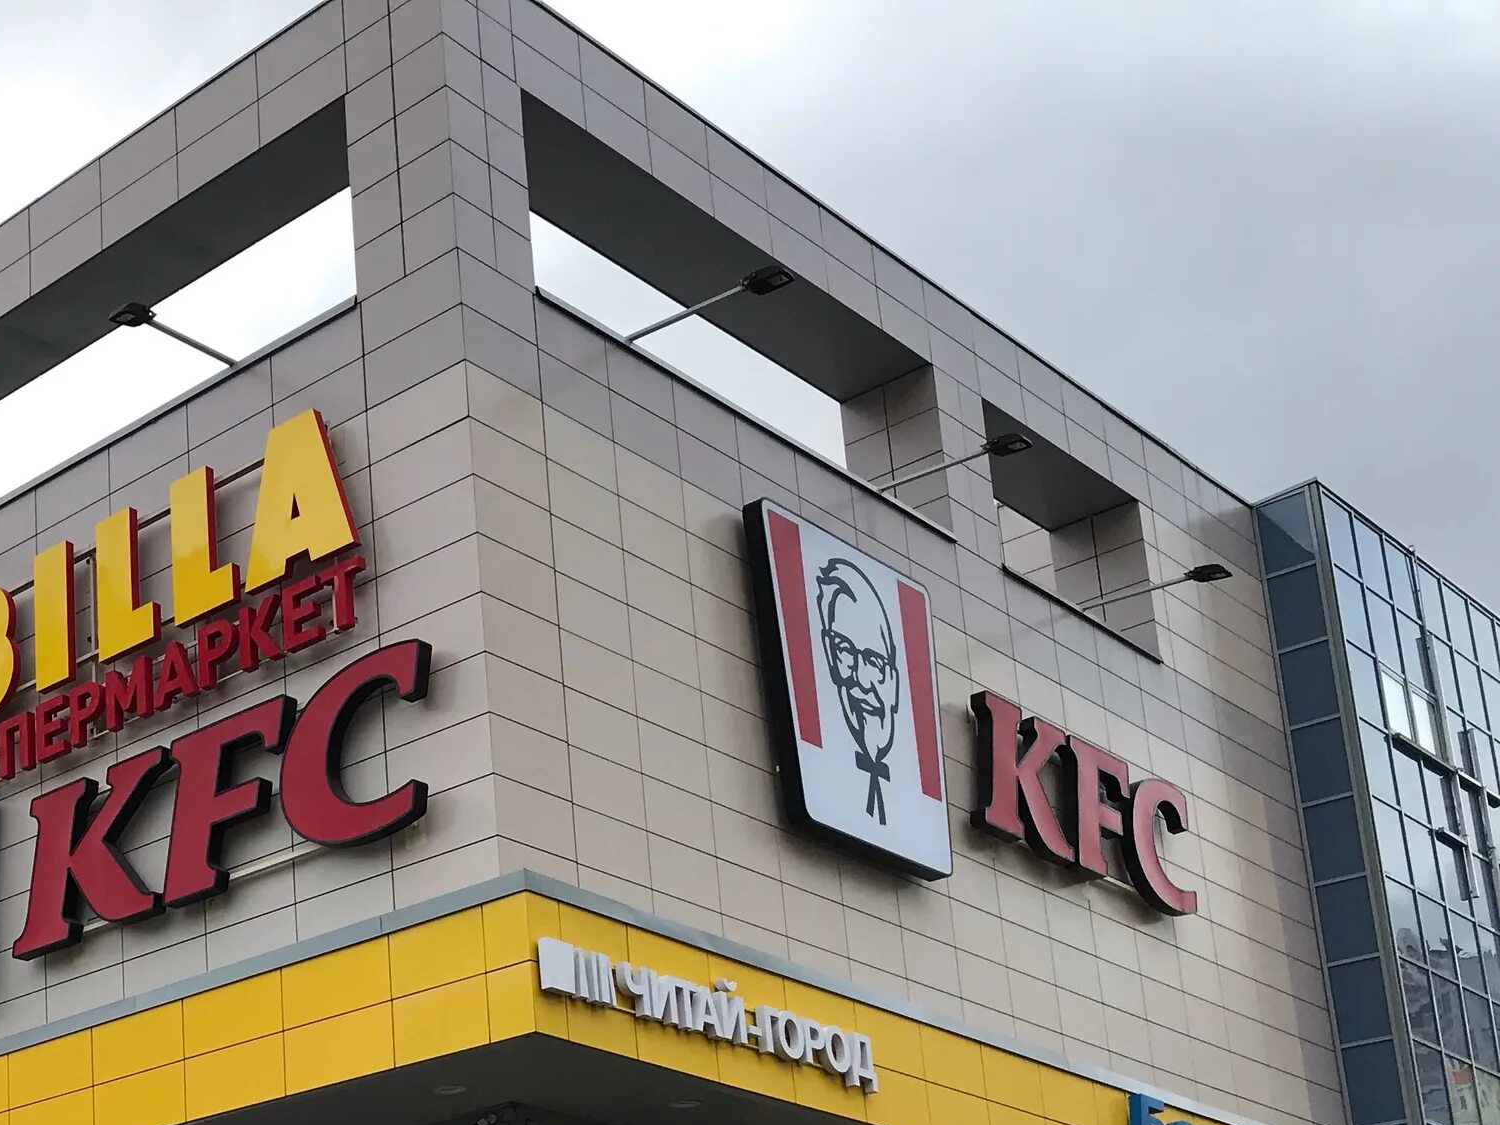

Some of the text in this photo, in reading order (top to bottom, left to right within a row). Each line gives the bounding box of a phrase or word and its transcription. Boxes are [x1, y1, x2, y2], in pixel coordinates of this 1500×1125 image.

[12, 640, 432, 960] KFC
[970, 691, 1197, 916] KFC
[616, 961, 879, 1094] ЧИТАЙ-ГОРОД
